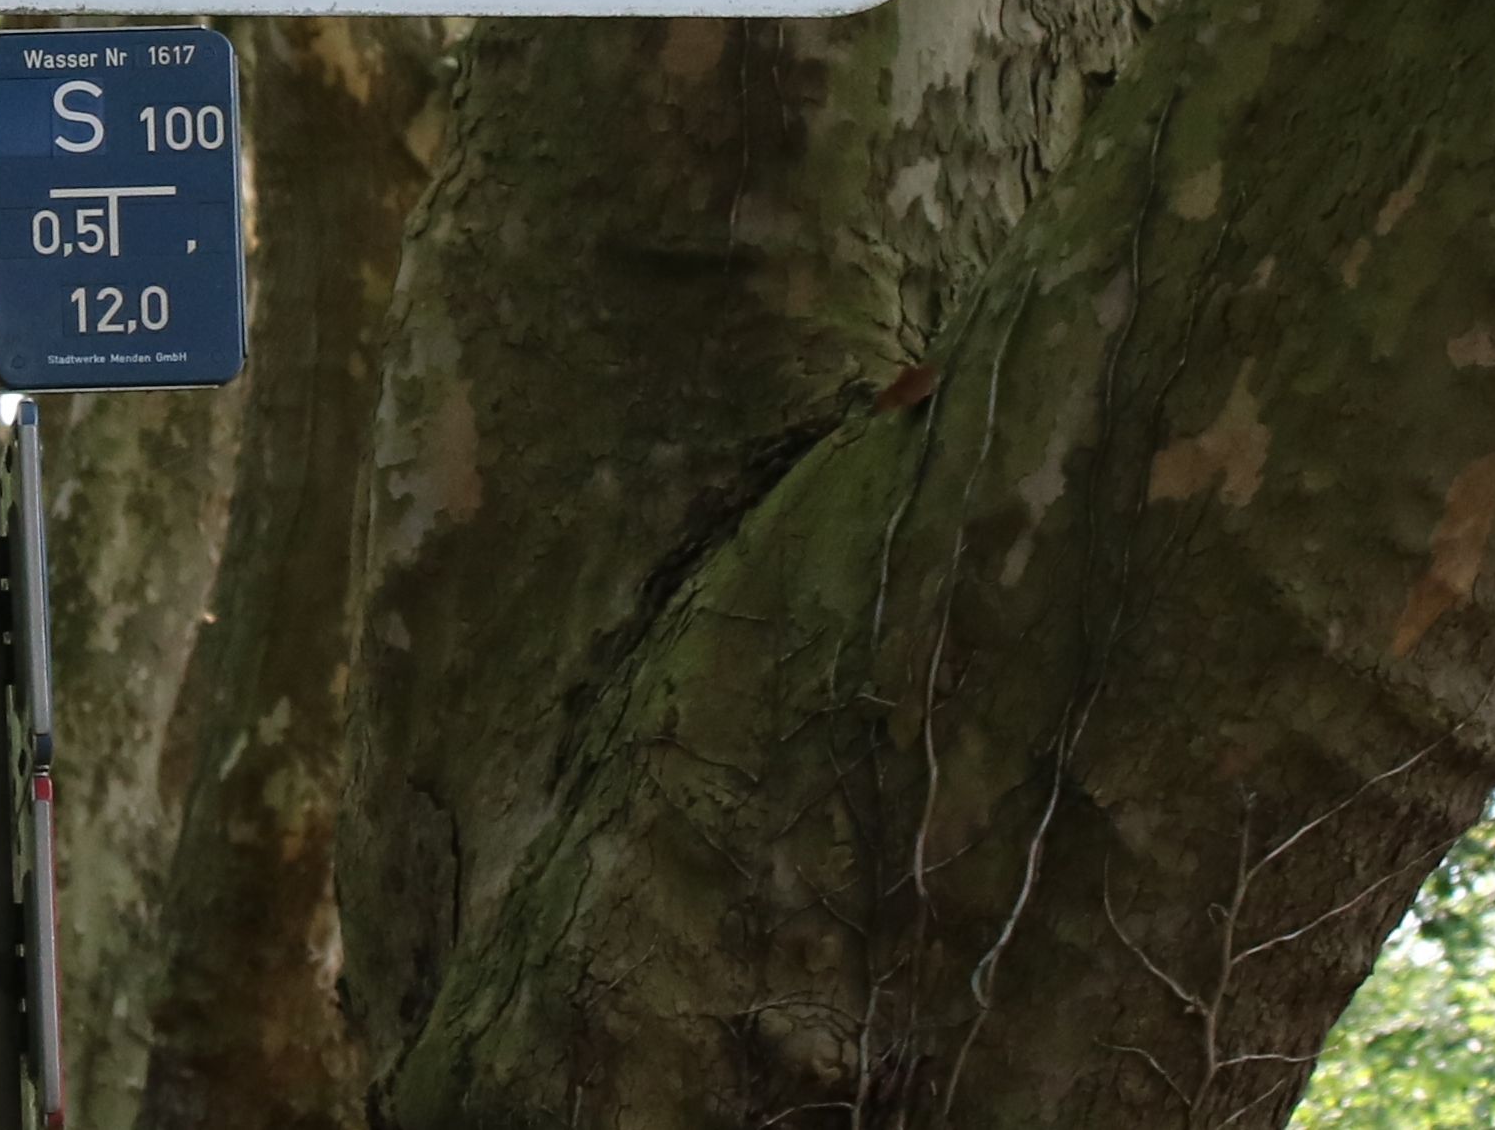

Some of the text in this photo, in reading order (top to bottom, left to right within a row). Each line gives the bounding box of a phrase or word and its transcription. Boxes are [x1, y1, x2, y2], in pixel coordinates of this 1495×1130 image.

[23, 44, 196, 69] Wasser Nr 1617
[52, 79, 225, 154] S 100
[70, 284, 170, 335] 12,0
[47, 352, 188, 365] Stadtwerke Menden GmbH
